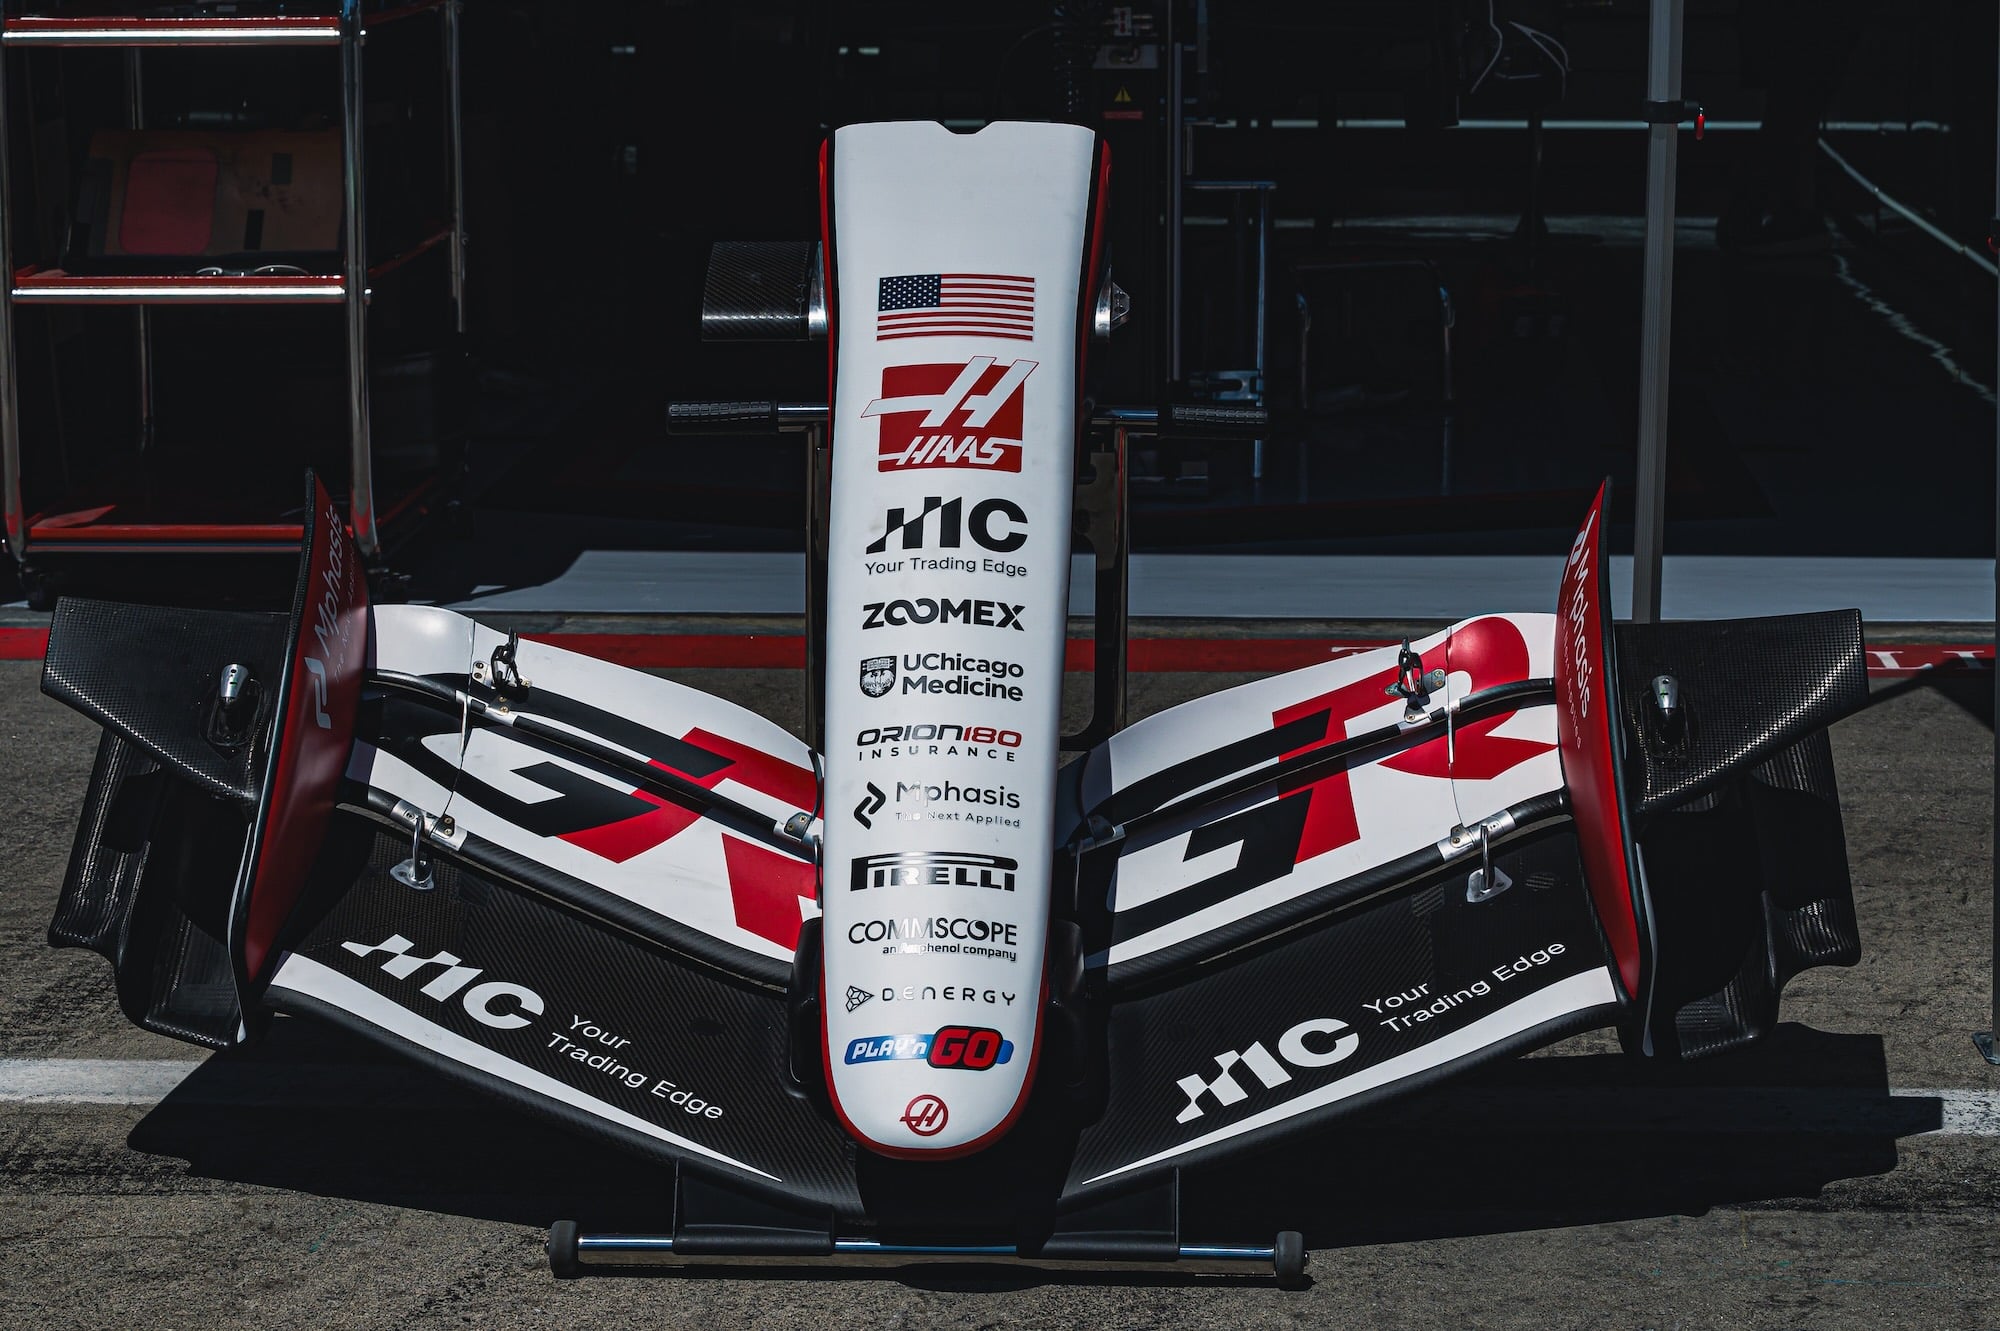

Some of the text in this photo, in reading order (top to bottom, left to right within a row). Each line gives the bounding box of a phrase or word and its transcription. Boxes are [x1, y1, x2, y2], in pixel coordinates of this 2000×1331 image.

[888, 435, 1012, 466] HAAS
[314, 504, 345, 657] Mphasis
[865, 557, 1027, 578] Your Trading Edge
[862, 597, 1026, 632] ZOOMEX
[1569, 547, 1593, 719] Mphasis
[903, 653, 1024, 679] UChicago
[902, 675, 1024, 702] Medicine
[856, 724, 1023, 748] ORION180
[858, 745, 1016, 762] INSURANCE
[896, 780, 1020, 809] Mphasis
[927, 811, 960, 821] Next
[965, 812, 1021, 828] Applied
[850, 851, 1019, 892] PIRELLI
[848, 917, 1018, 946] COMMSCOPE
[882, 946, 897, 955] an
[963, 946, 1017, 962] company
[1362, 981, 1430, 1015] Your
[1380, 941, 1566, 1032] Trading Edge
[570, 1014, 631, 1050] Your
[929, 1027, 1001, 1069] GO
[548, 1032, 724, 1119] Trading Edge
